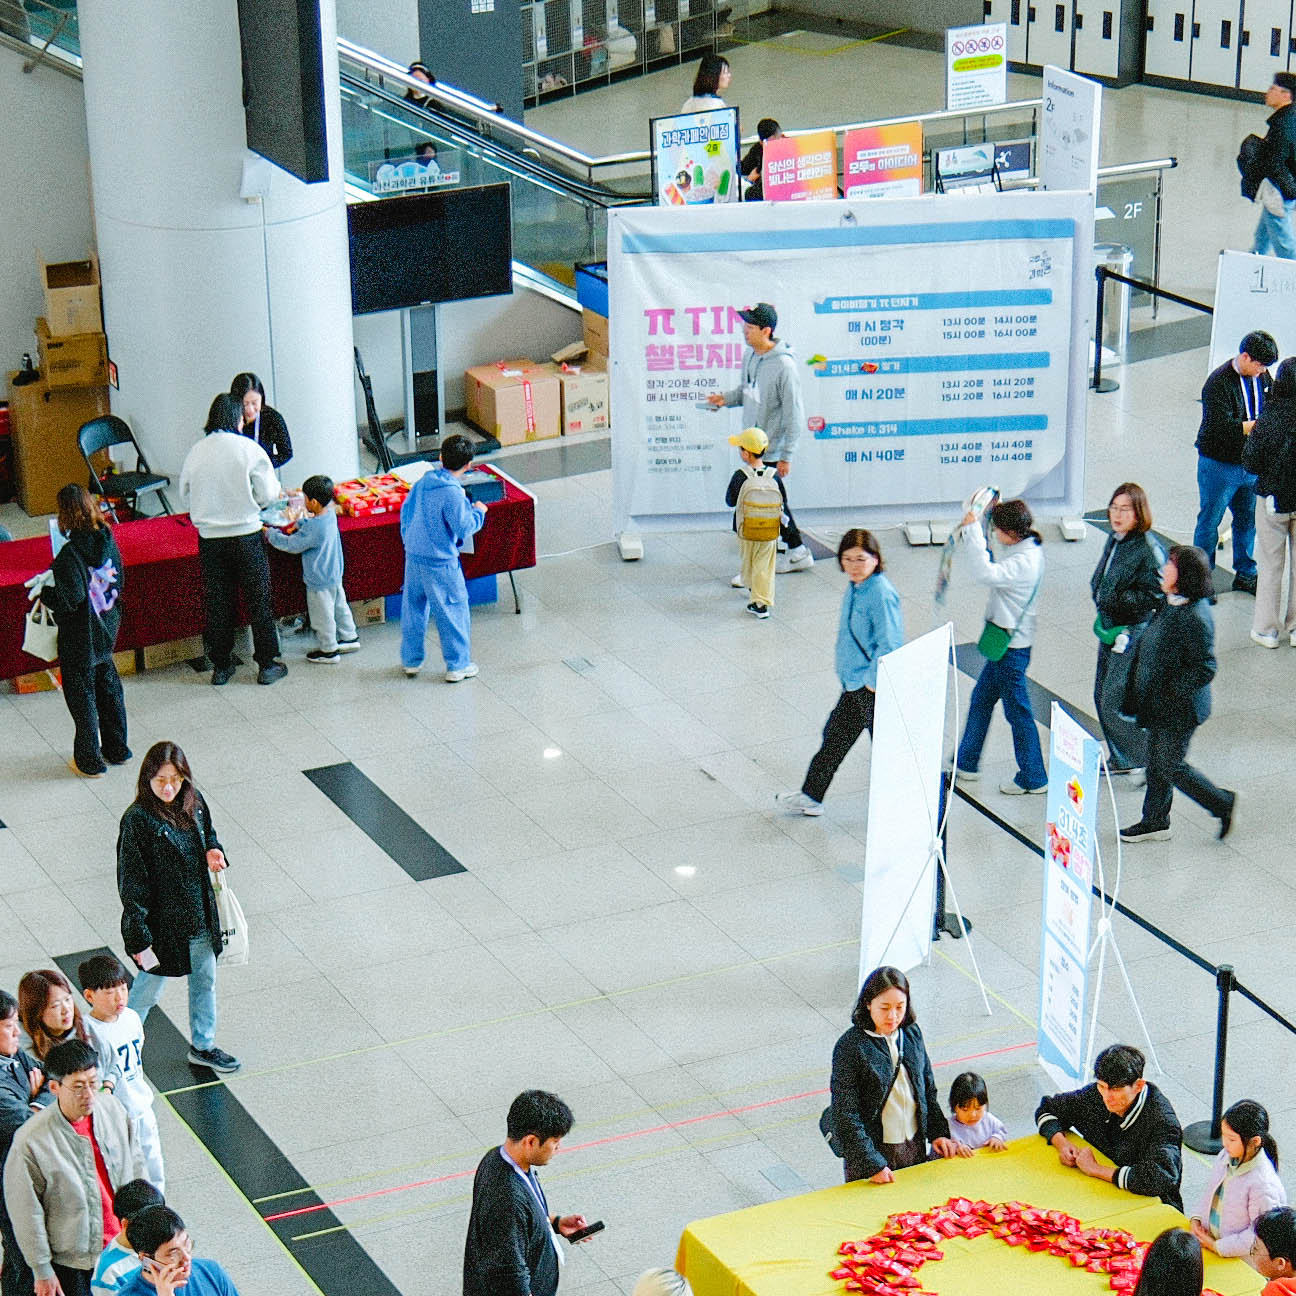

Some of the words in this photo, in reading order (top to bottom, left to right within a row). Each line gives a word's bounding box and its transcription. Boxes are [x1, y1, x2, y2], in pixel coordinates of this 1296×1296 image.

[1123, 202, 1143, 219] 2F
[684, 305, 762, 335] TIM
[879, 423, 898, 433] 314
